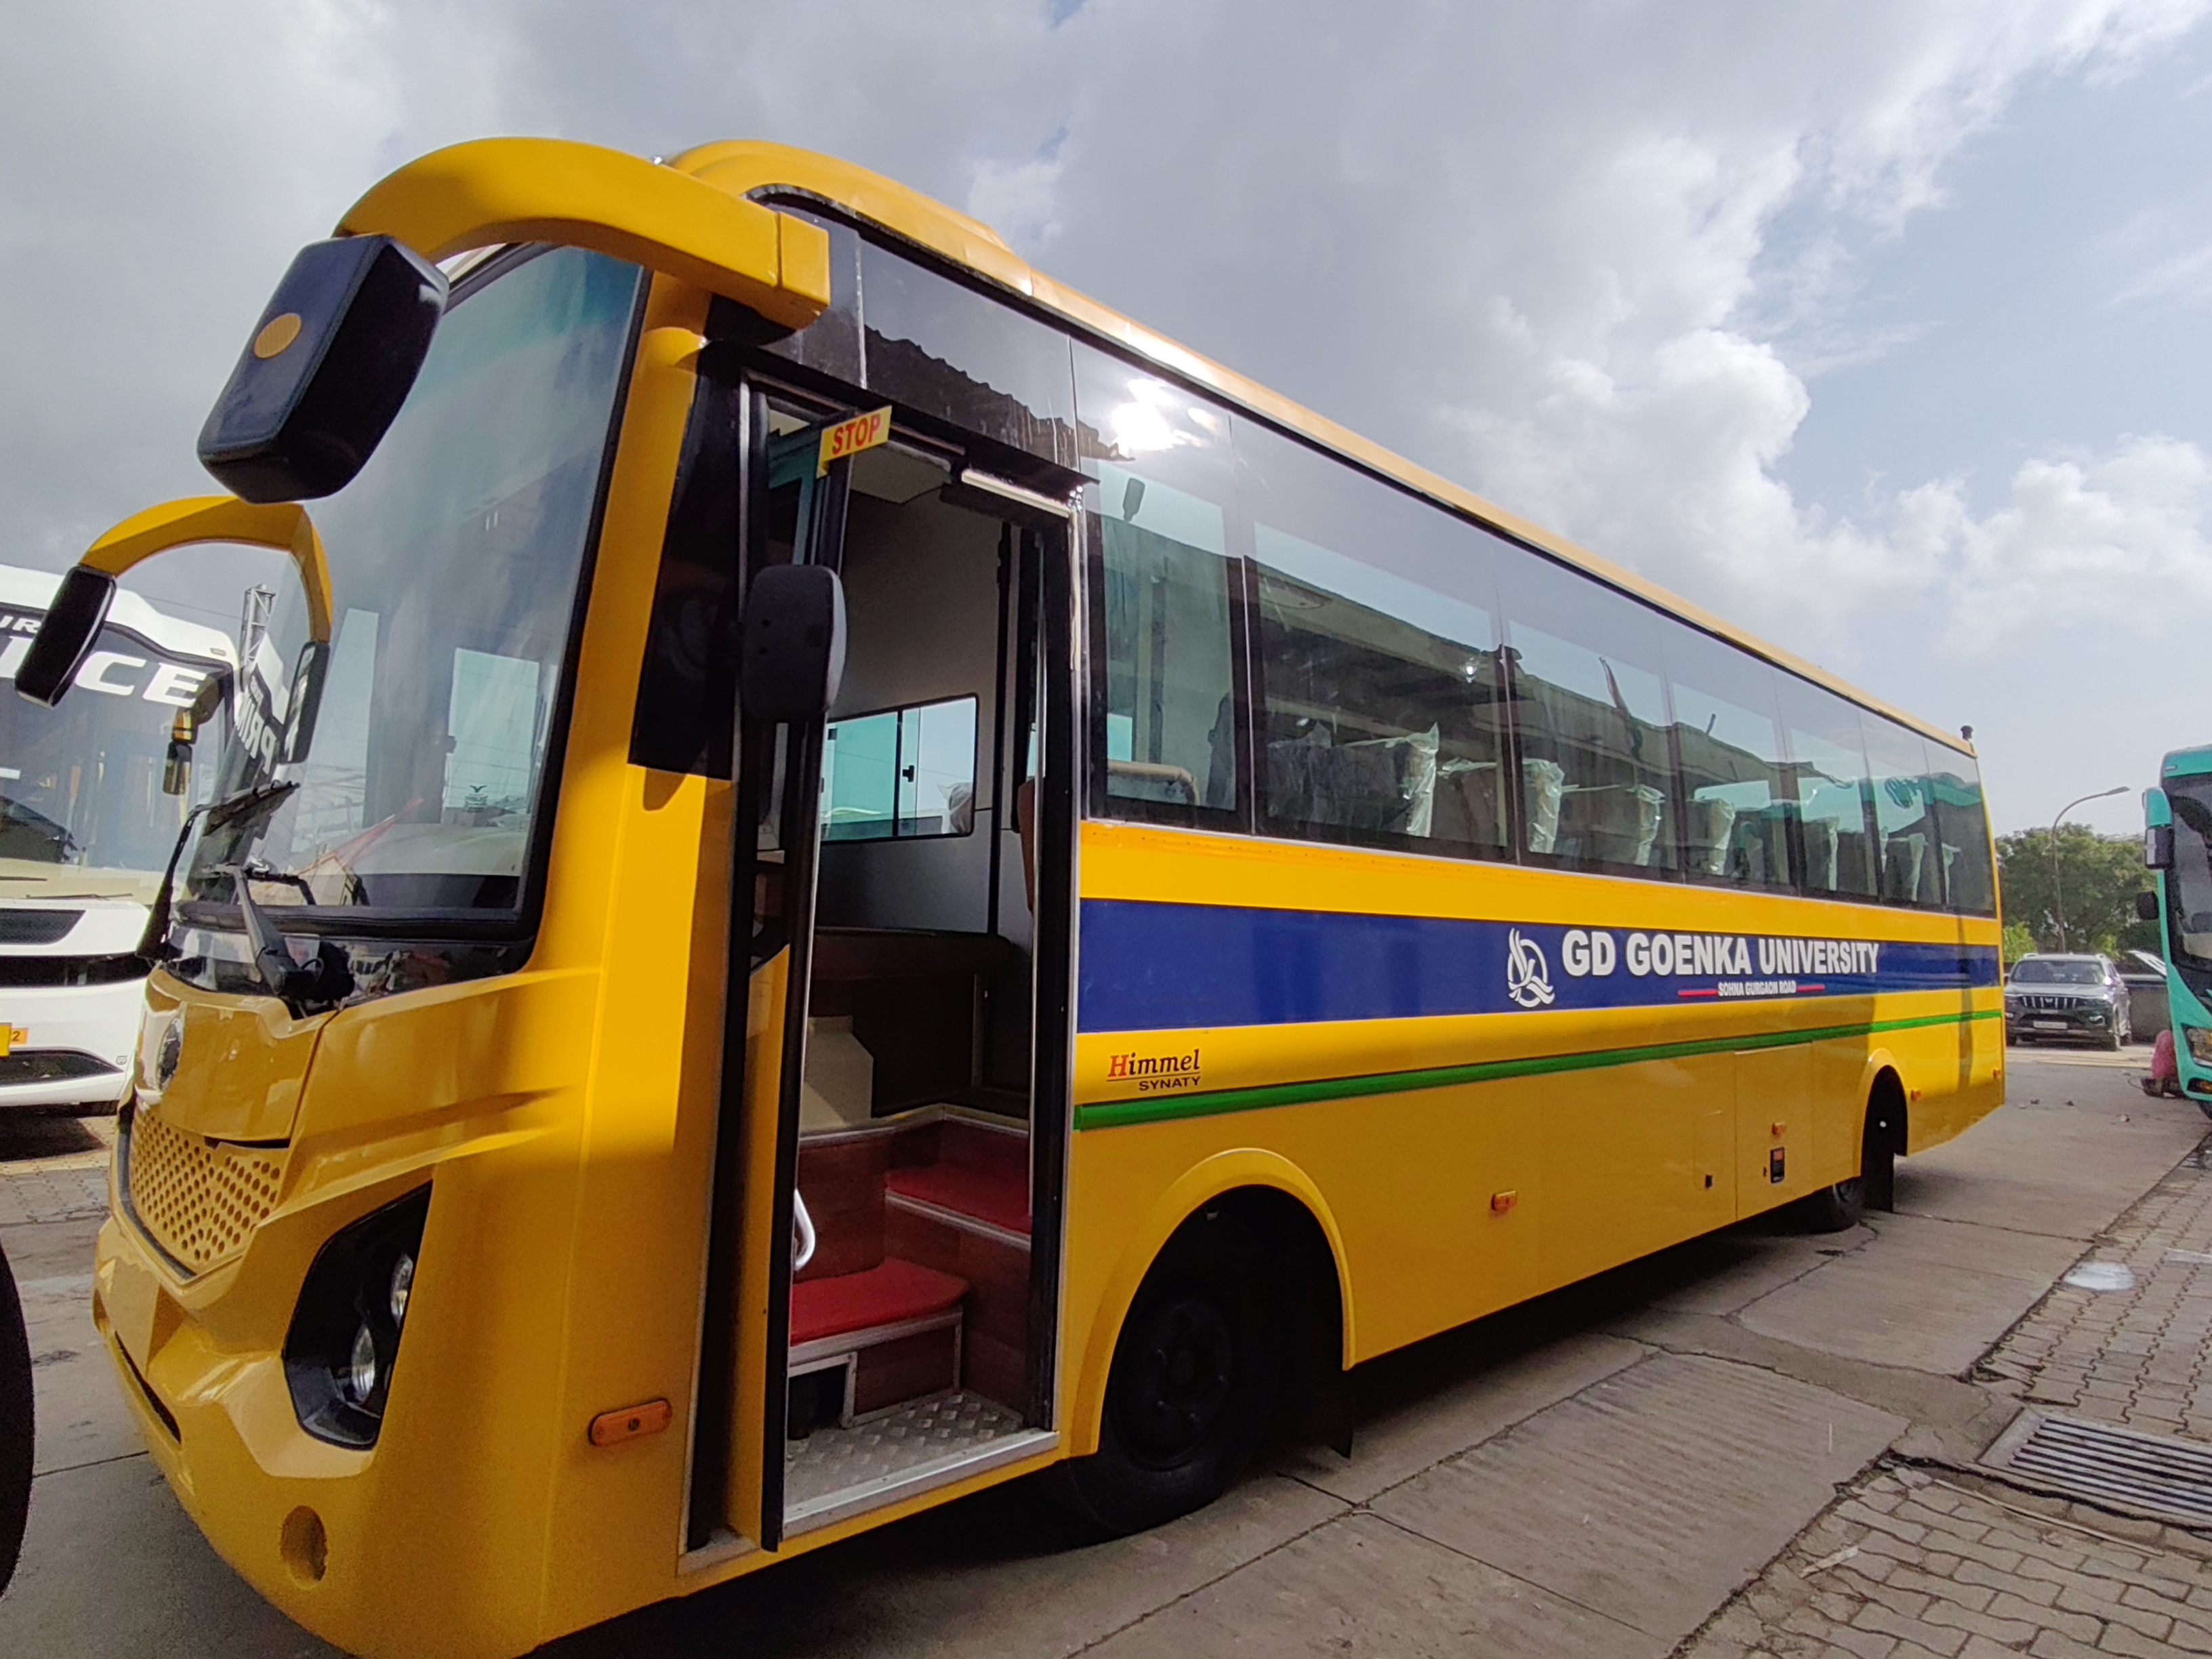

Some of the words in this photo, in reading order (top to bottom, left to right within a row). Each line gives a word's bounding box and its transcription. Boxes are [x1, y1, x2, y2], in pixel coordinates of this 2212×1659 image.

[832, 414, 880, 455] STOP
[1561, 930, 1616, 977] GD
[1626, 933, 1753, 976] GOENKA
[1759, 937, 1879, 975] UNIVERSITY
[1718, 981, 1745, 996] SOHNA
[1745, 981, 1778, 996] GURGAON
[1779, 980, 1797, 994] ROAD
[1107, 1048, 1200, 1078] Himmel
[1139, 1077, 1200, 1091] SYNATY
